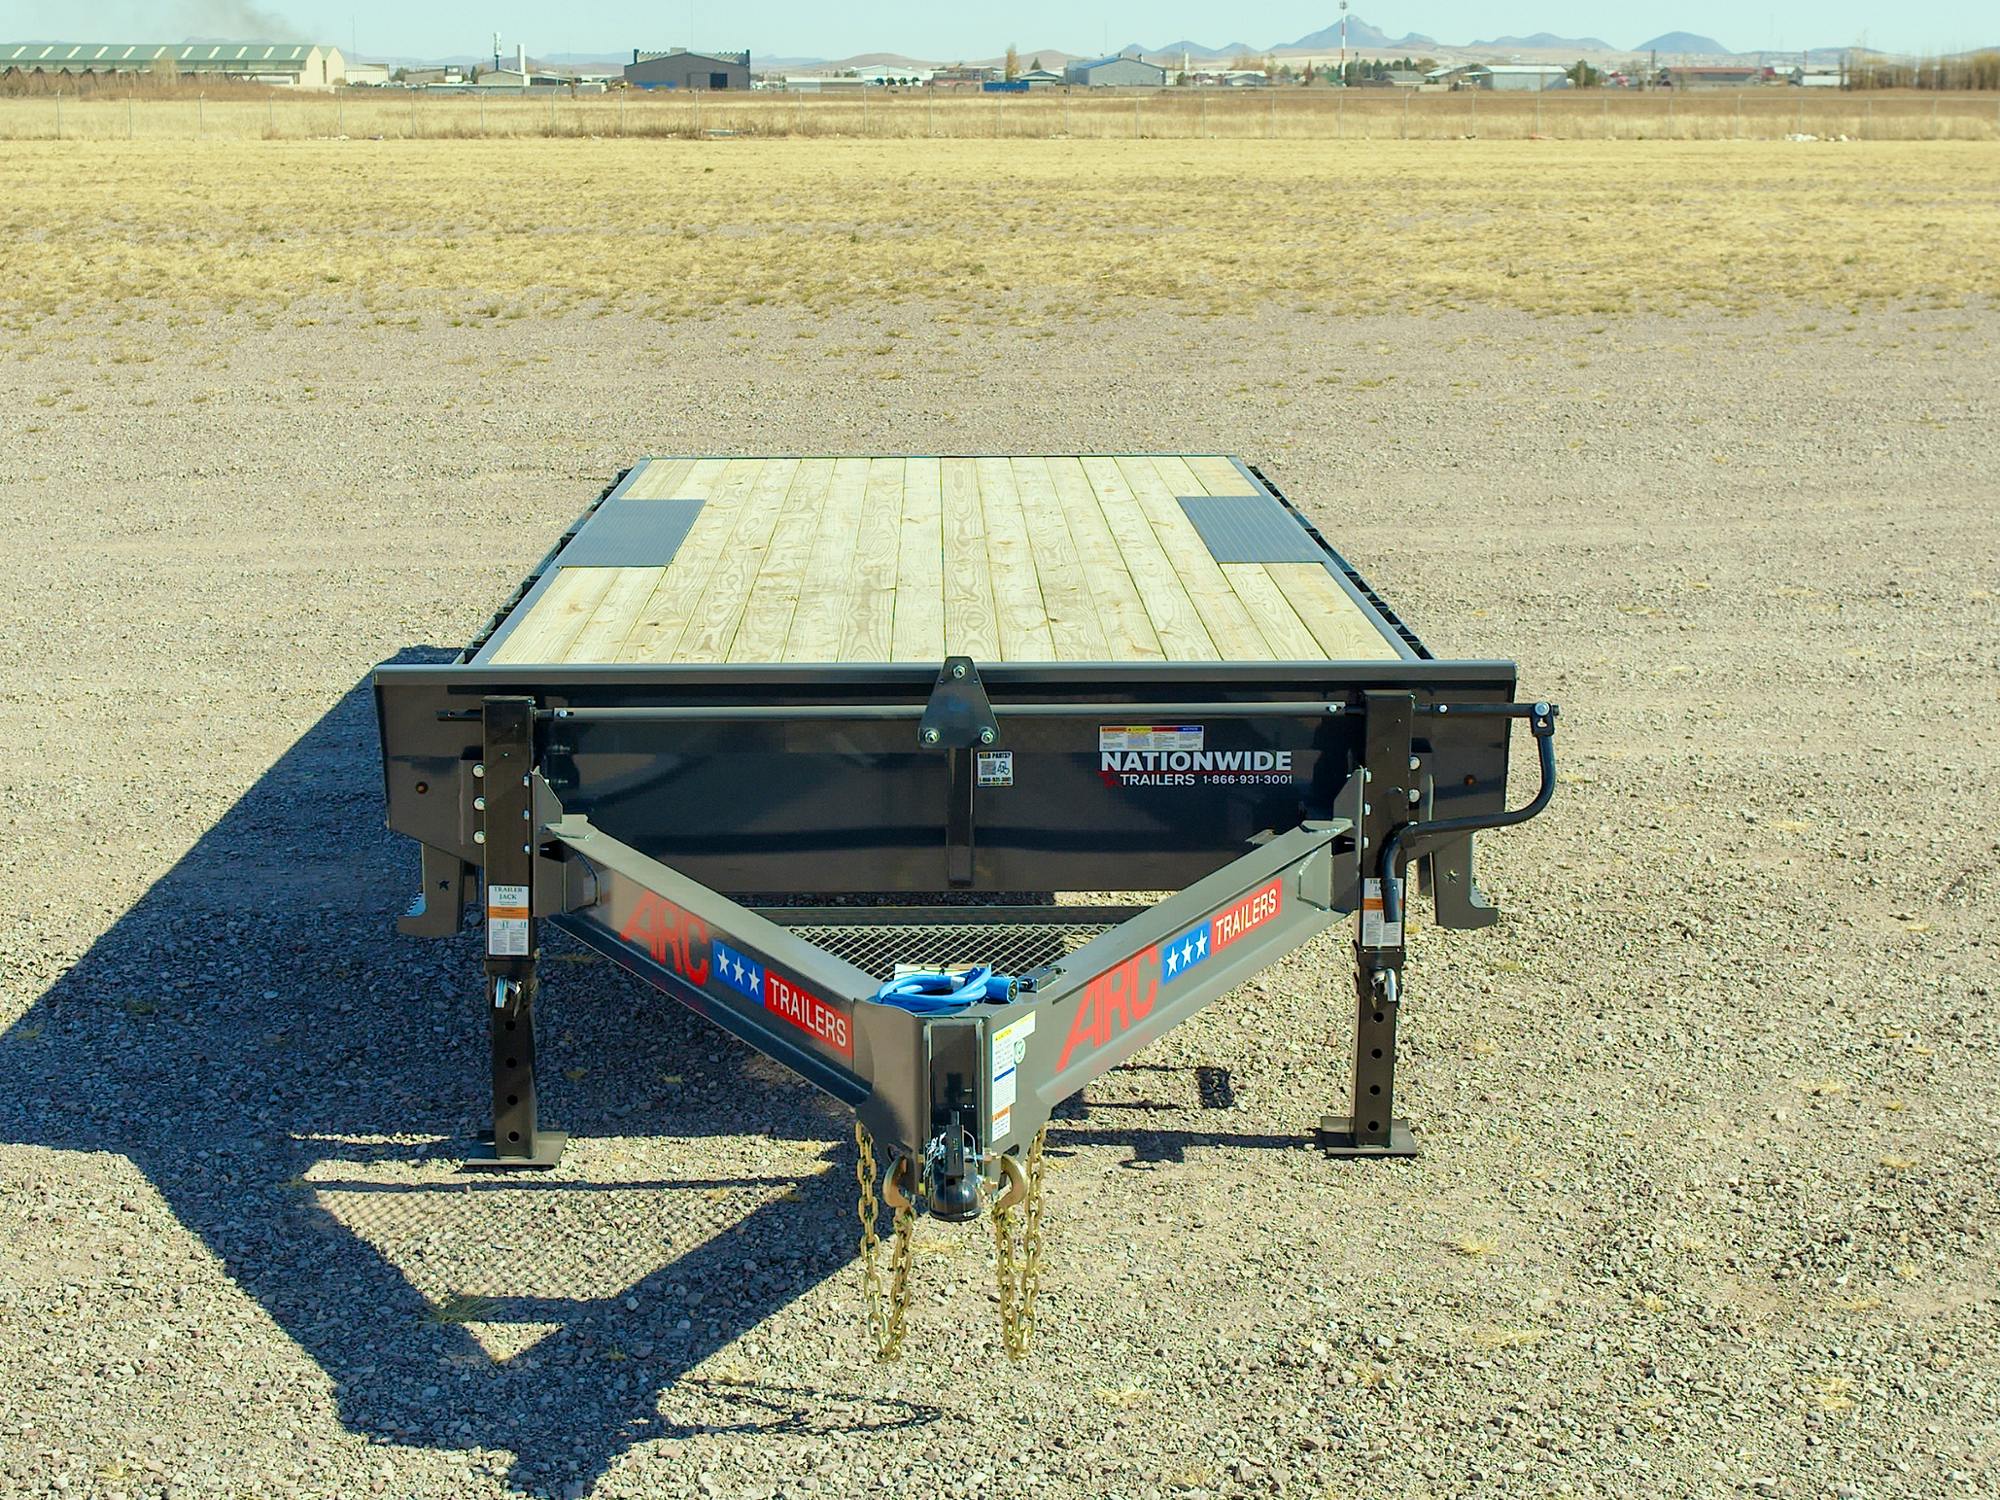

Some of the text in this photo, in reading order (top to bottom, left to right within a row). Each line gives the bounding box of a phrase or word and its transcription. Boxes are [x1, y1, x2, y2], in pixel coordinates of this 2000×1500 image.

[1101, 751, 1292, 771] NATIONWIDE
[1120, 774, 1293, 785] TRAILERS 1-866-931-3001
[620, 888, 846, 1047] ARC TRAILERS
[1056, 888, 1277, 1073] ARC TRAILERS
